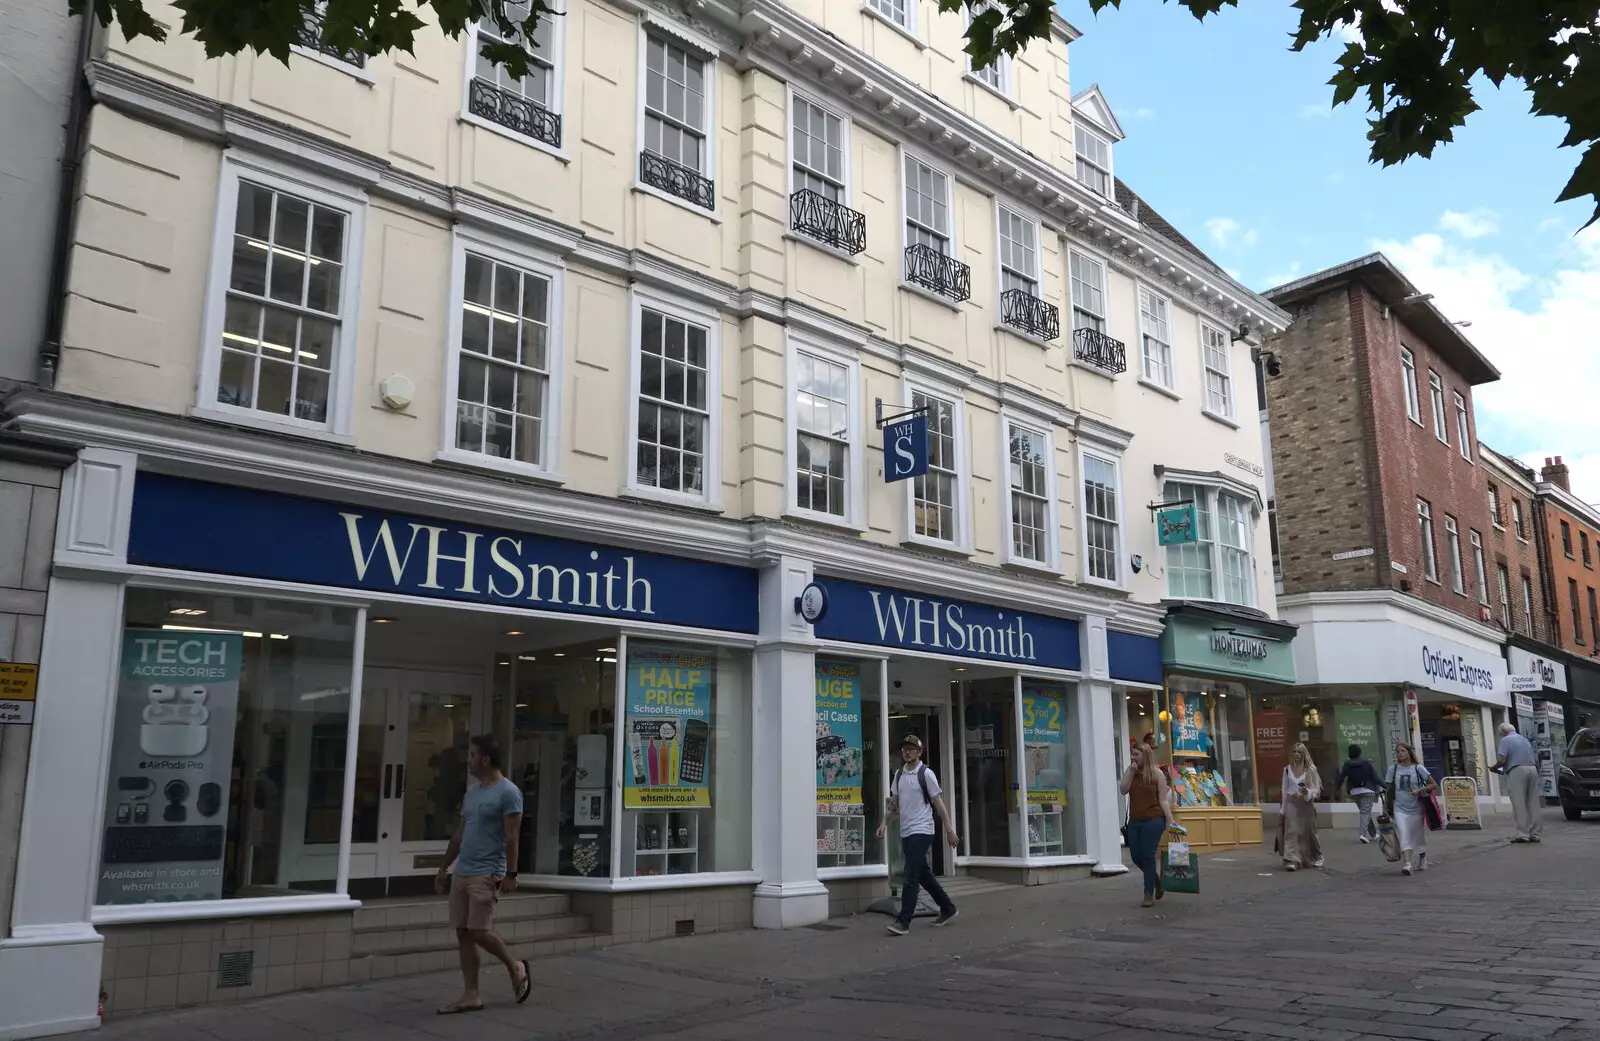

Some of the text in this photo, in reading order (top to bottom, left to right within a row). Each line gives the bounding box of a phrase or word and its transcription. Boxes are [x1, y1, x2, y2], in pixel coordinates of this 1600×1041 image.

[895, 423, 913, 437] WH
[895, 436, 915, 475] S
[338, 512, 655, 615] WHSmith
[868, 590, 1036, 660] WHSmith
[135, 638, 228, 665] TECH
[132, 665, 226, 678] ACCESSORIES
[1422, 645, 1493, 692] Optical Express
[639, 665, 702, 690] HALF
[1511, 676, 1533, 684] Optical
[645, 690, 696, 707] PRICE
[634, 704, 704, 716] School Essentials
[831, 711, 858, 722] Cases
[1023, 698, 1035, 728] 3
[1048, 700, 1061, 729] 2
[1256, 727, 1285, 738] FREE
[147, 761, 204, 770] AirPods Pro
[640, 793, 697, 802] whsmith.co.uk
[103, 869, 153, 880] Available
[170, 868, 197, 878] store
[200, 867, 220, 877] and
[122, 878, 201, 893] whsmith.co.uk
